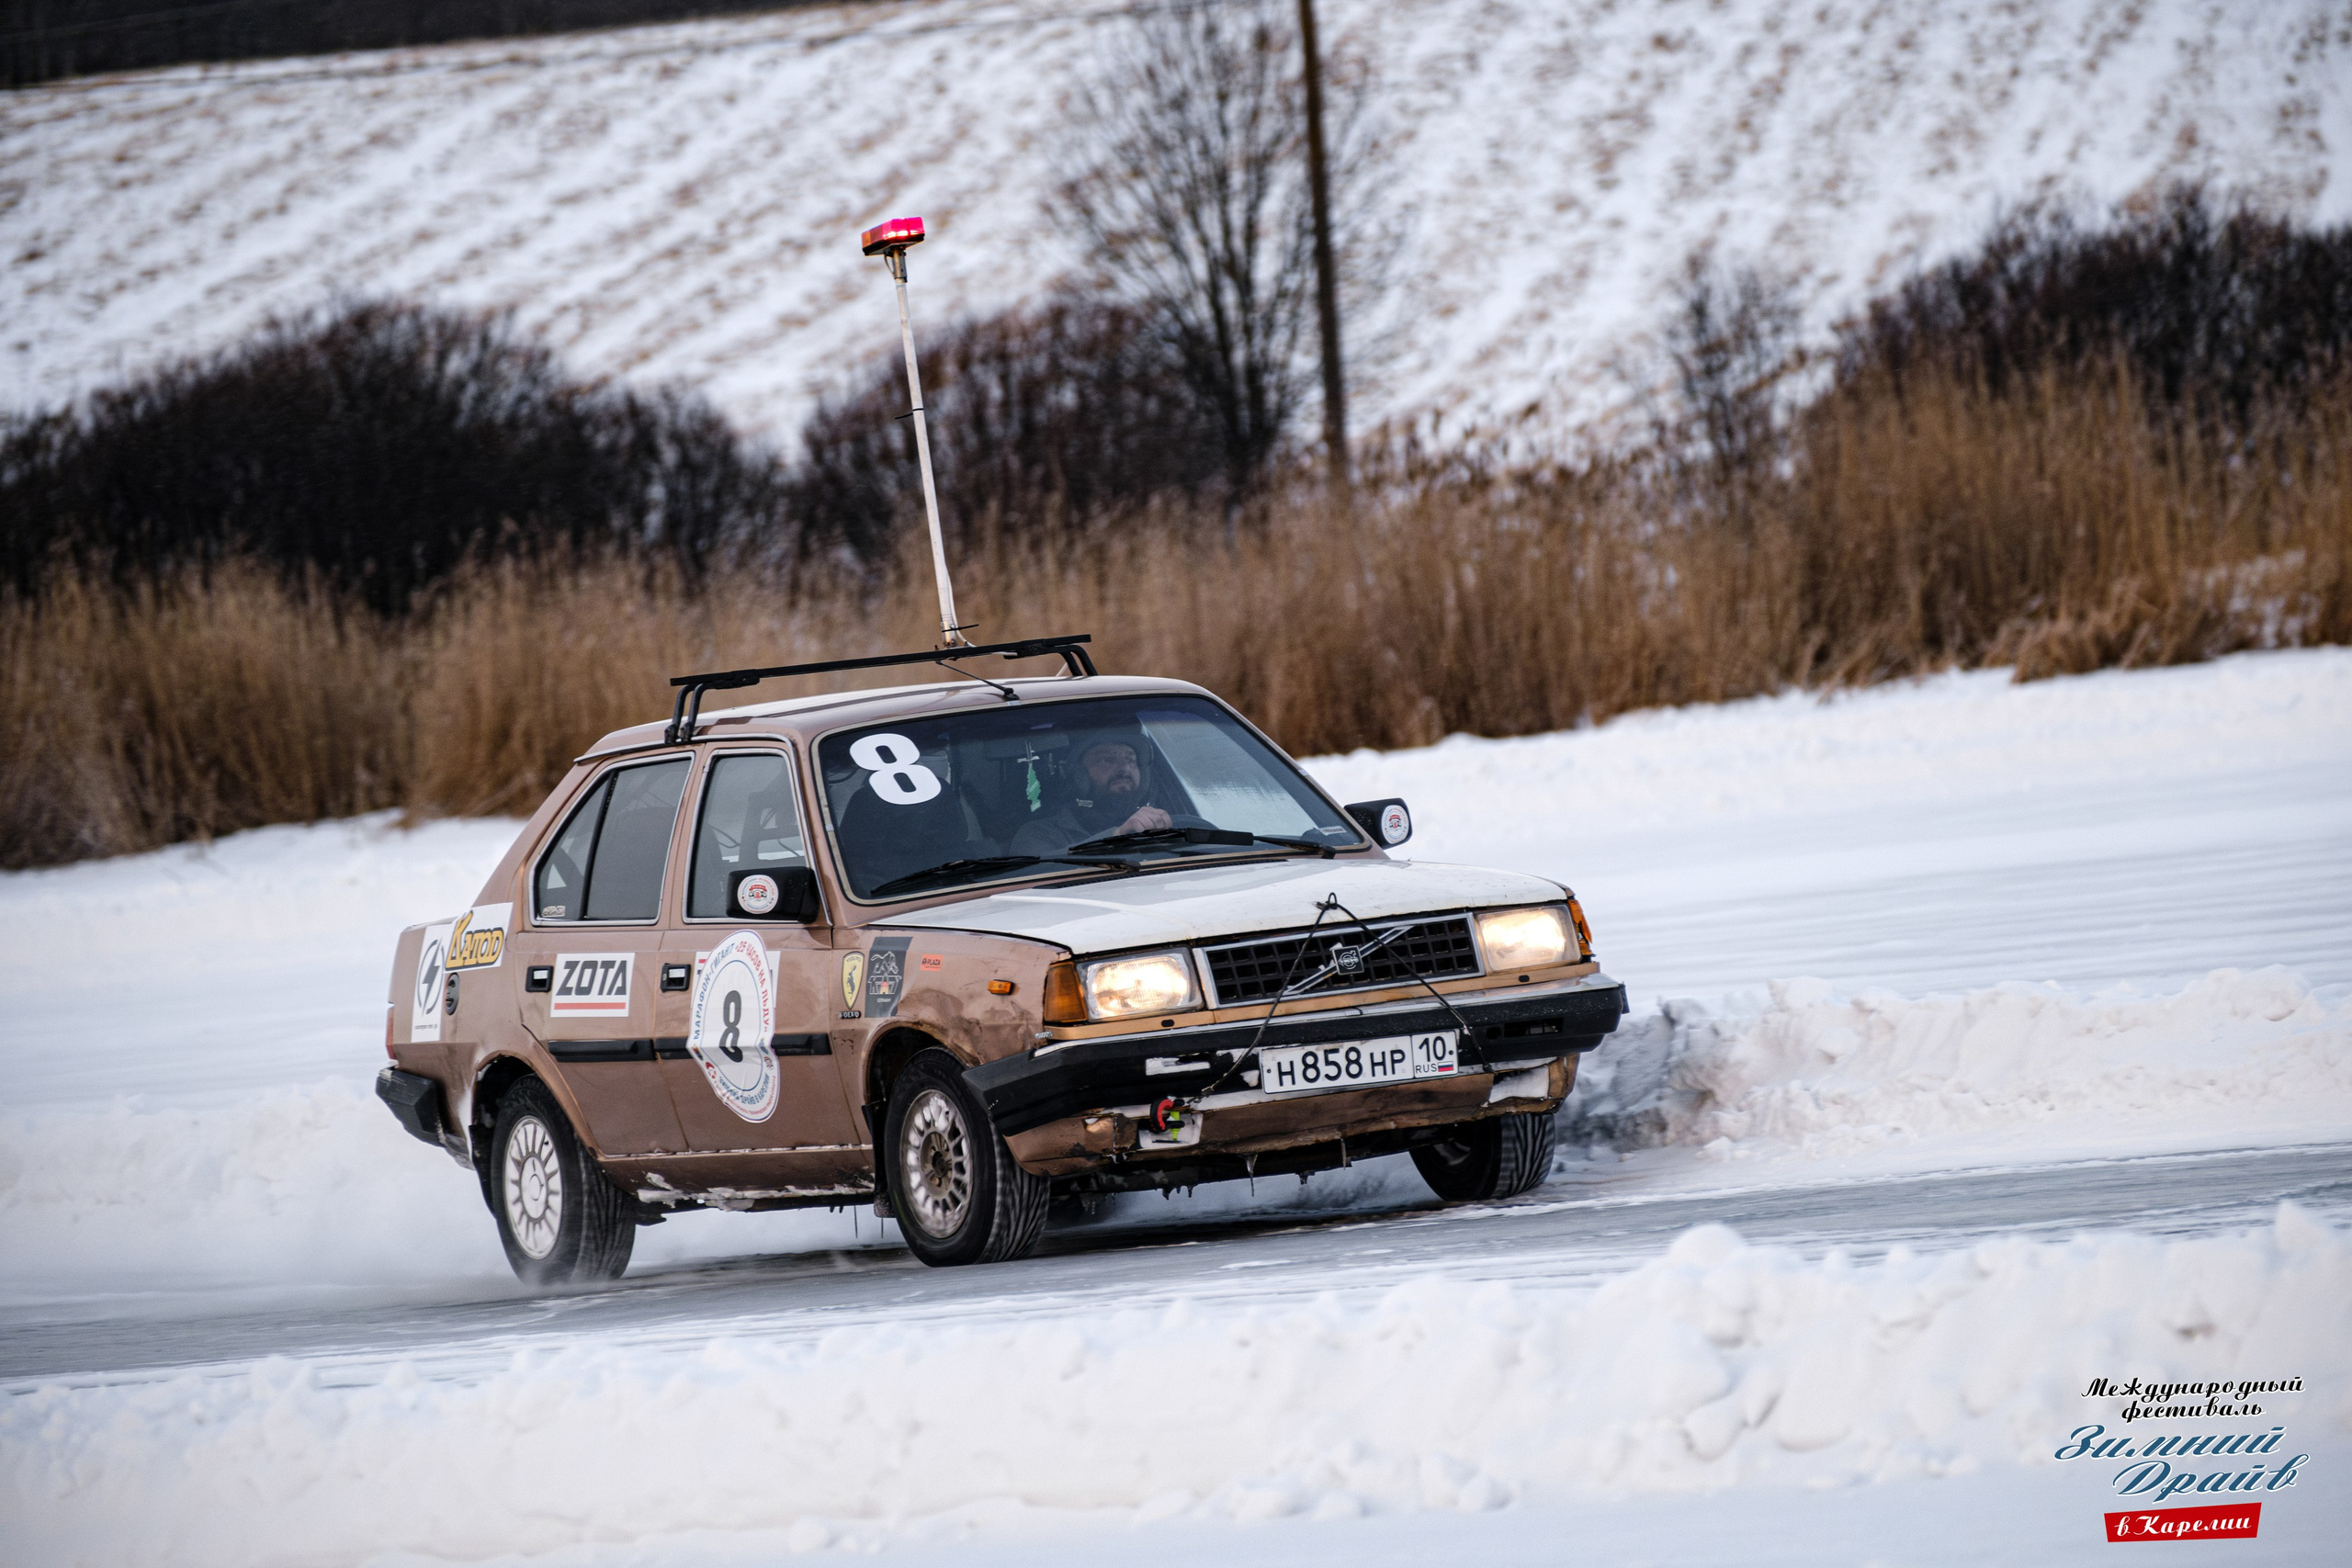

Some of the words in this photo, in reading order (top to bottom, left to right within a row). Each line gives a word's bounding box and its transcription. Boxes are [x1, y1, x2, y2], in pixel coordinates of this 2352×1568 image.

[850, 733, 942, 805] 8
[556, 960, 627, 996] ZOTA
[694, 942, 735, 1040] МАРАФОН-ГИГАНТ
[719, 990, 743, 1063] 8
[1419, 1036, 1447, 1061] 10
[1416, 1063, 1437, 1074] RUS
